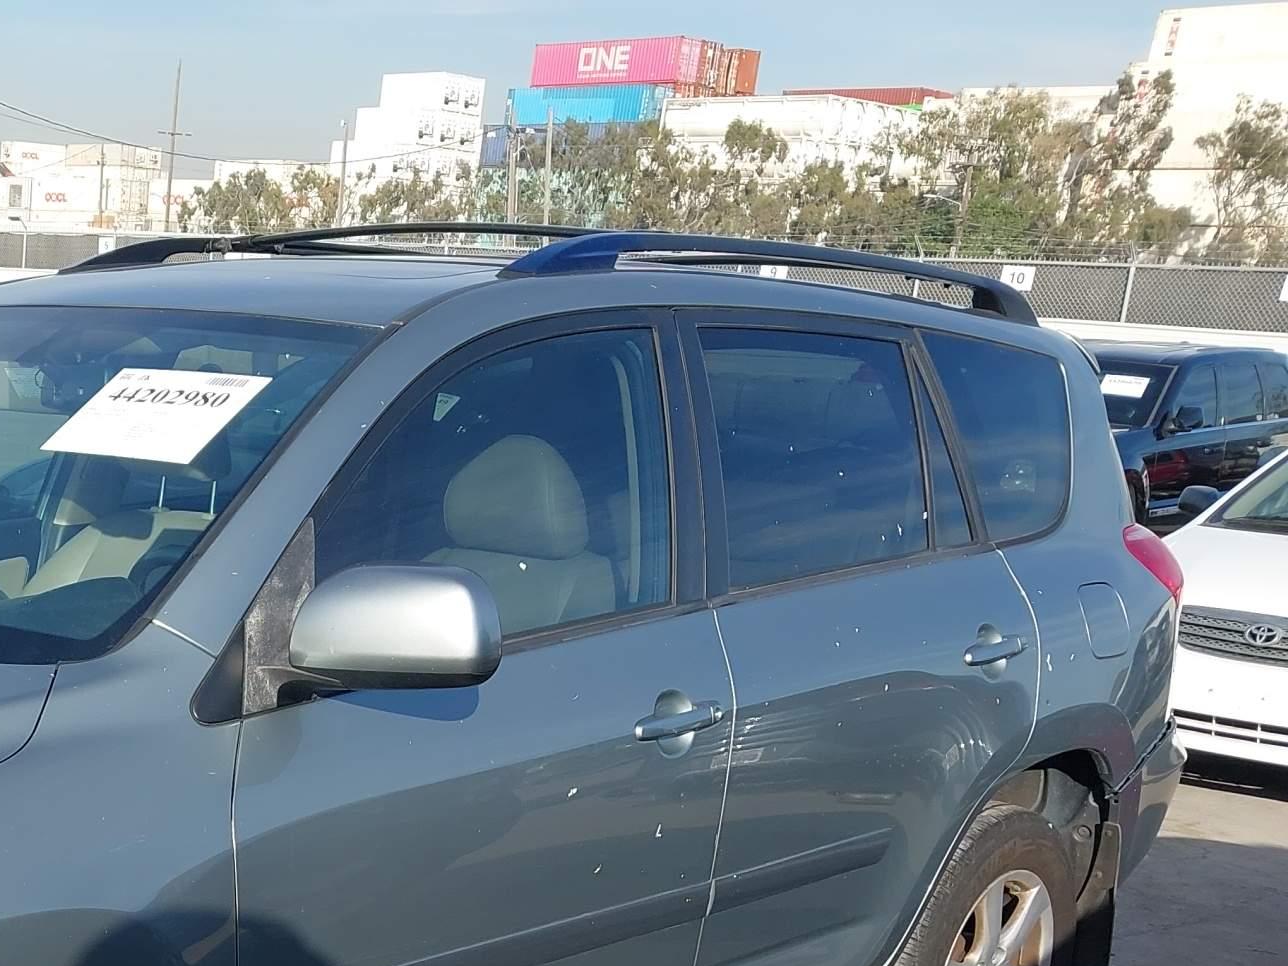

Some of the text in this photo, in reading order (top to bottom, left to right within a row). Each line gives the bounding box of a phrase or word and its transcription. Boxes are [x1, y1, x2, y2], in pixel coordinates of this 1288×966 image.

[577, 45, 631, 71] ONE
[45, 192, 68, 203] OOCL
[103, 240, 110, 250] 5
[770, 266, 777, 277] 9
[1009, 271, 1025, 285] 10
[108, 386, 231, 408] 44202980
